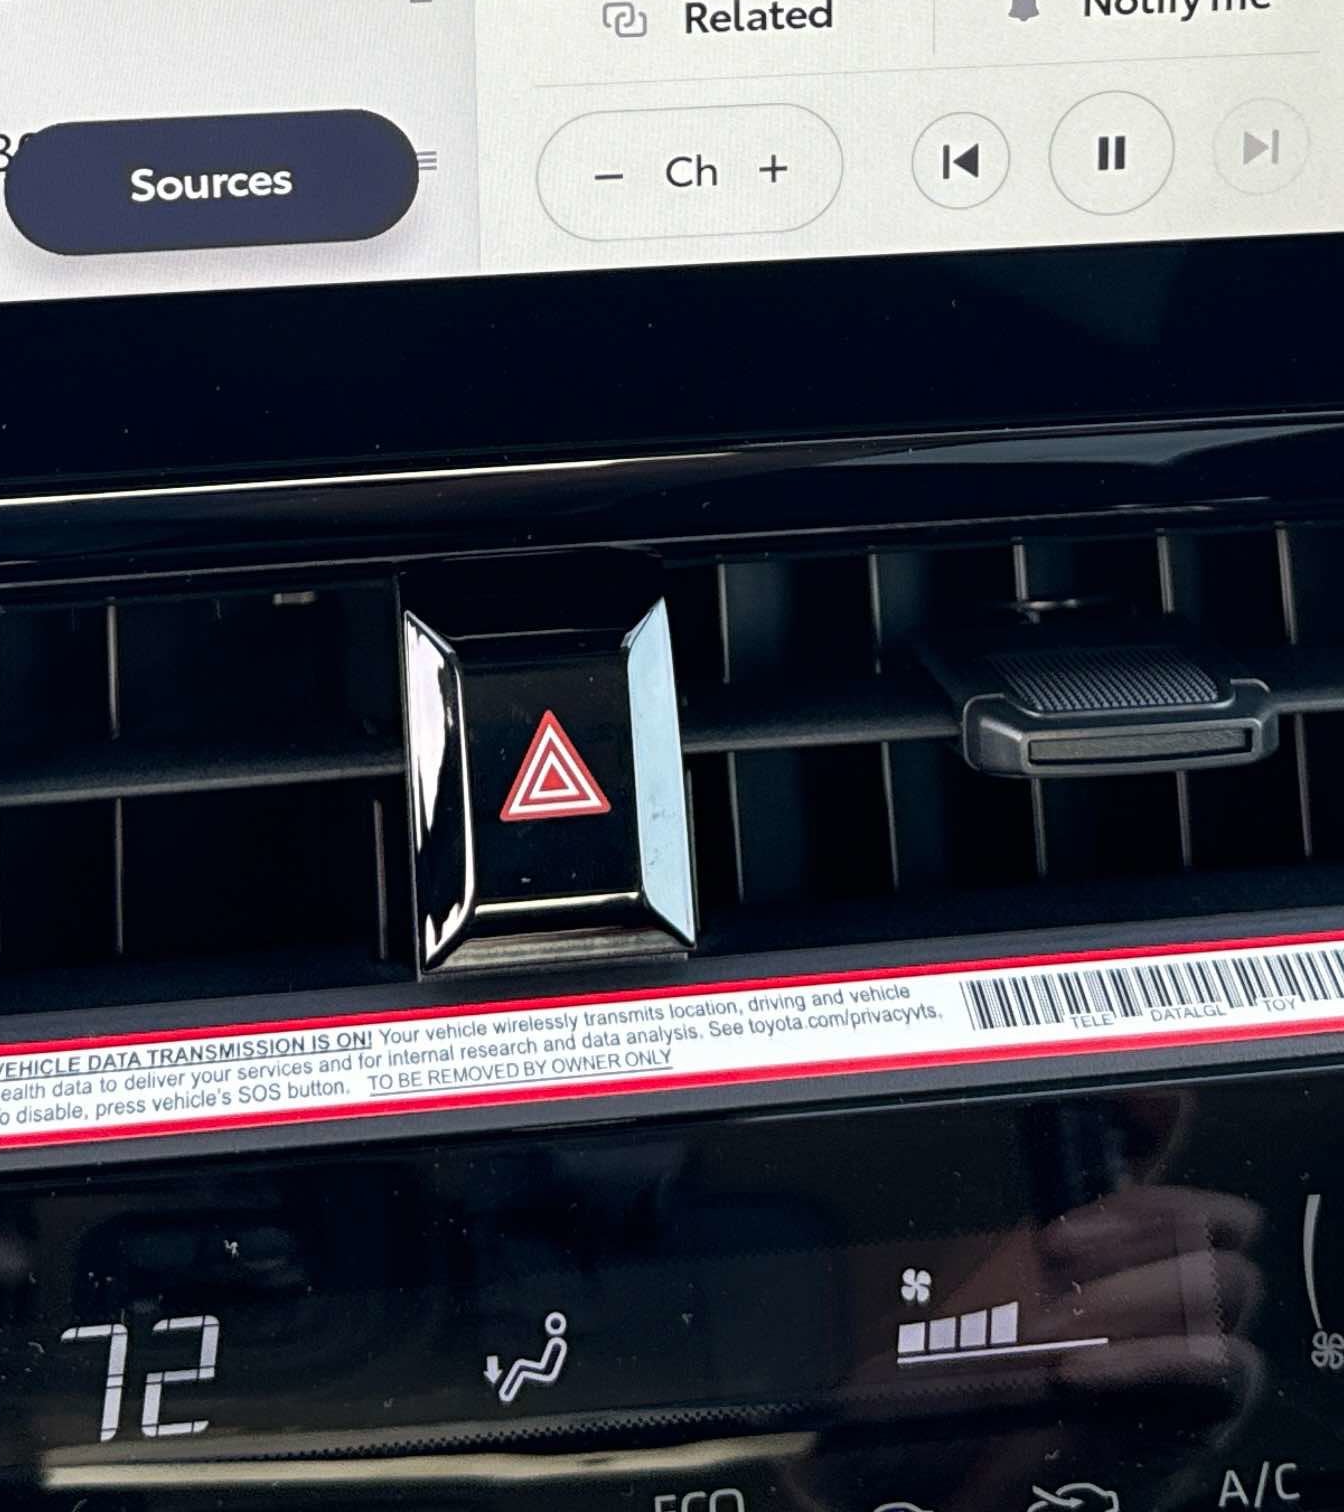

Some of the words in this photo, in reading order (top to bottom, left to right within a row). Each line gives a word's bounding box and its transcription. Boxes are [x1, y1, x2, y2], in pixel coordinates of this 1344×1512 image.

[131, 166, 293, 203] Sources
[665, 155, 718, 189] Ch
[88, 1051, 141, 1071] DATA
[147, 1035, 305, 1065] TRANSMISSION
[312, 1034, 330, 1050] IS
[337, 1031, 372, 1047] ON!
[379, 1028, 419, 1045] Your
[425, 1020, 487, 1041] vehicle
[493, 1011, 578, 1035] wirelessly
[584, 1005, 664, 1026] transmits
[669, 999, 743, 1019] location,
[748, 994, 807, 1012] driving
[812, 990, 844, 1007] and
[849, 983, 911, 1002] vehicle
[1069, 1012, 1112, 1030] TELE
[1151, 1004, 1227, 1023] DATALGL
[1262, 997, 1298, 1013] TOY
[16, 1101, 88, 1124] disable,
[96, 1097, 146, 1120] press
[152, 1086, 232, 1112] vehicle's
[238, 1082, 281, 1104] SOS
[288, 1079, 350, 1100] button.
[368, 1074, 393, 1091] TO
[399, 1070, 422, 1087] BE
[428, 1061, 520, 1085] REMOVED
[524, 1059, 547, 1076] BY
[552, 1052, 621, 1074] OWNER
[625, 1047, 672, 1069] ONLY
[52, 1079, 93, 1097] data
[100, 1076, 117, 1093] to
[124, 1070, 185, 1090] deliver
[191, 1066, 231, 1089] your
[238, 1059, 313, 1080] services
[319, 1055, 353, 1073] and
[359, 1051, 381, 1069] for
[388, 1044, 454, 1065] internal
[460, 1035, 538, 1059] research
[543, 1033, 576, 1052] and
[582, 1029, 620, 1048] data
[627, 1023, 704, 1045] analysis.
[709, 1019, 743, 1038] See
[61, 1315, 219, 1443] 72
[1217, 1462, 1301, 1508] A/C
